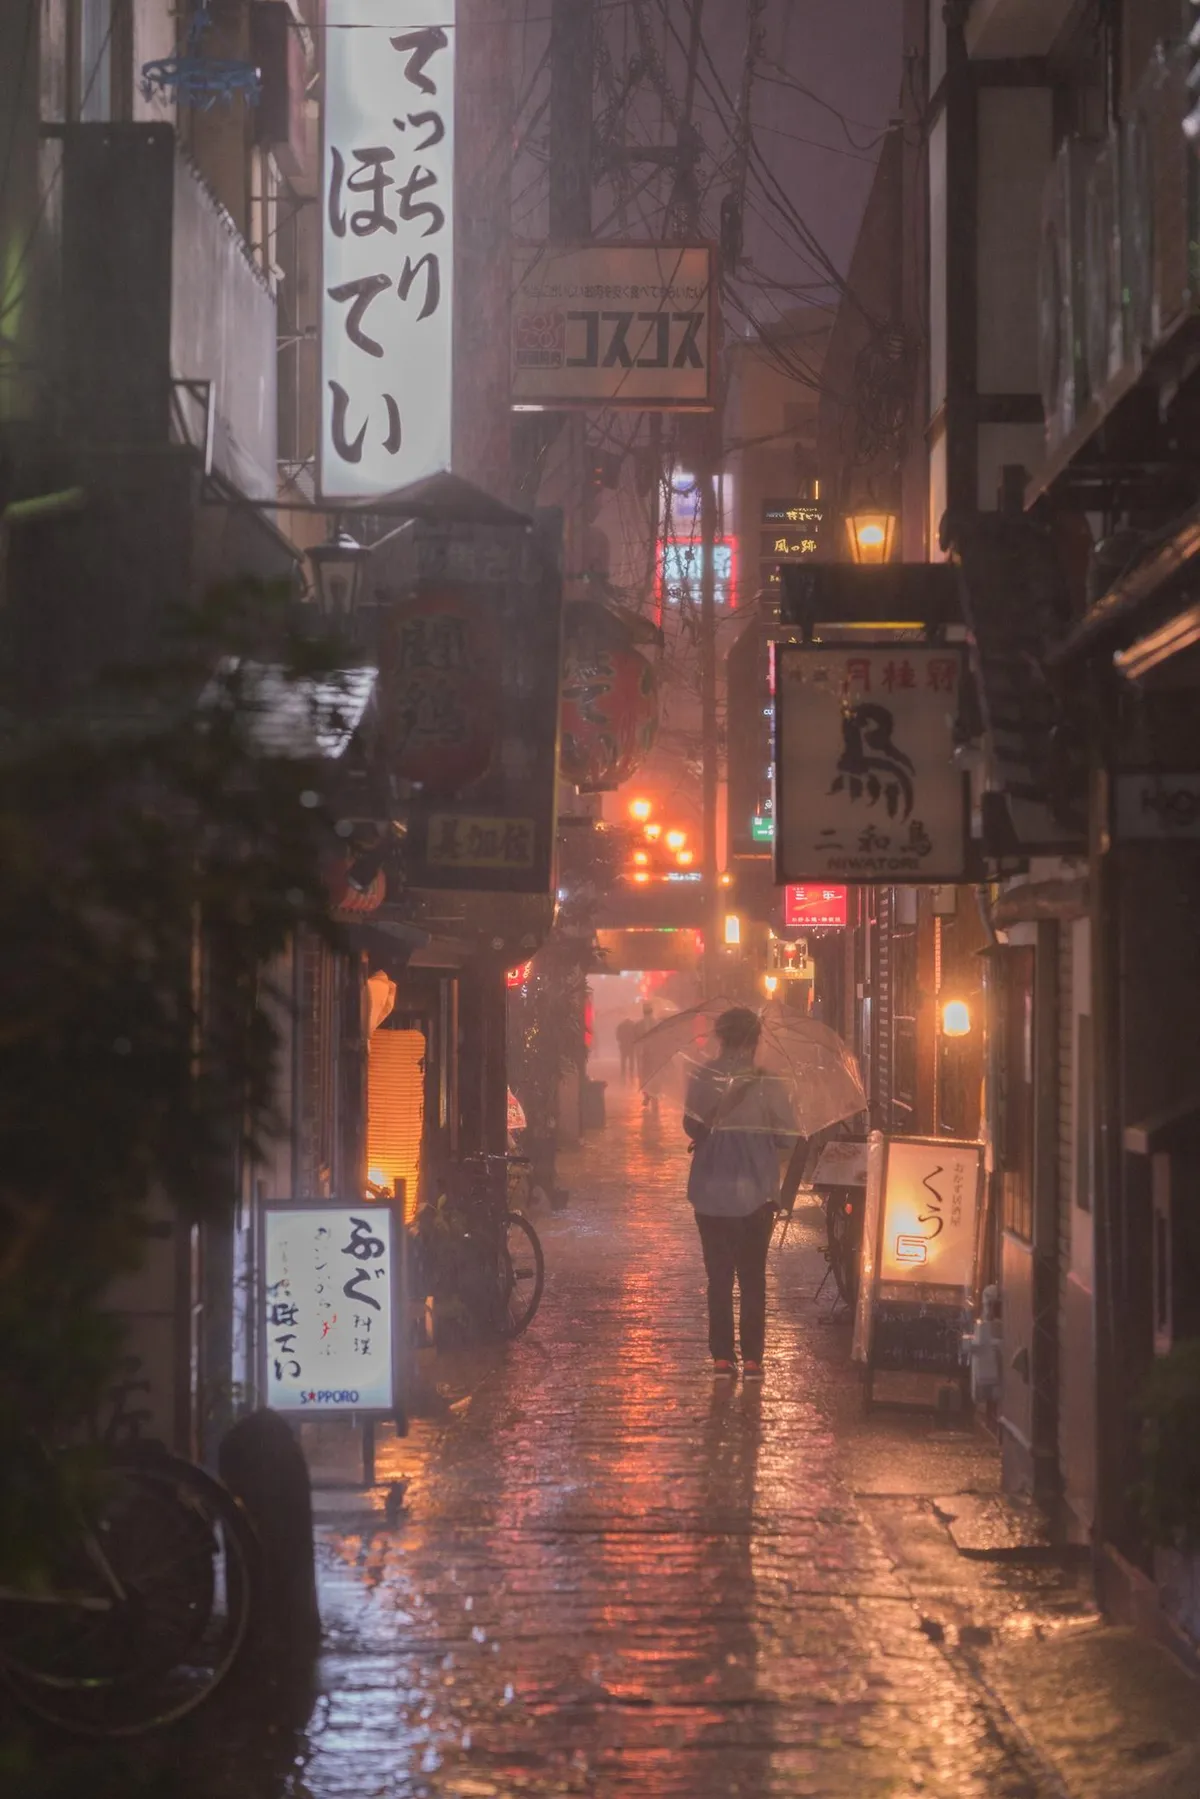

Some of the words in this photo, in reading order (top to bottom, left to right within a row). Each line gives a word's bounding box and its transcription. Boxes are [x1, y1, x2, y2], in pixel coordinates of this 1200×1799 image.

[389, 27, 449, 322] てっちり
[327, 145, 401, 464] ほてい
[566, 310, 705, 369] コスコス
[814, 820, 933, 857] 二和鳥
